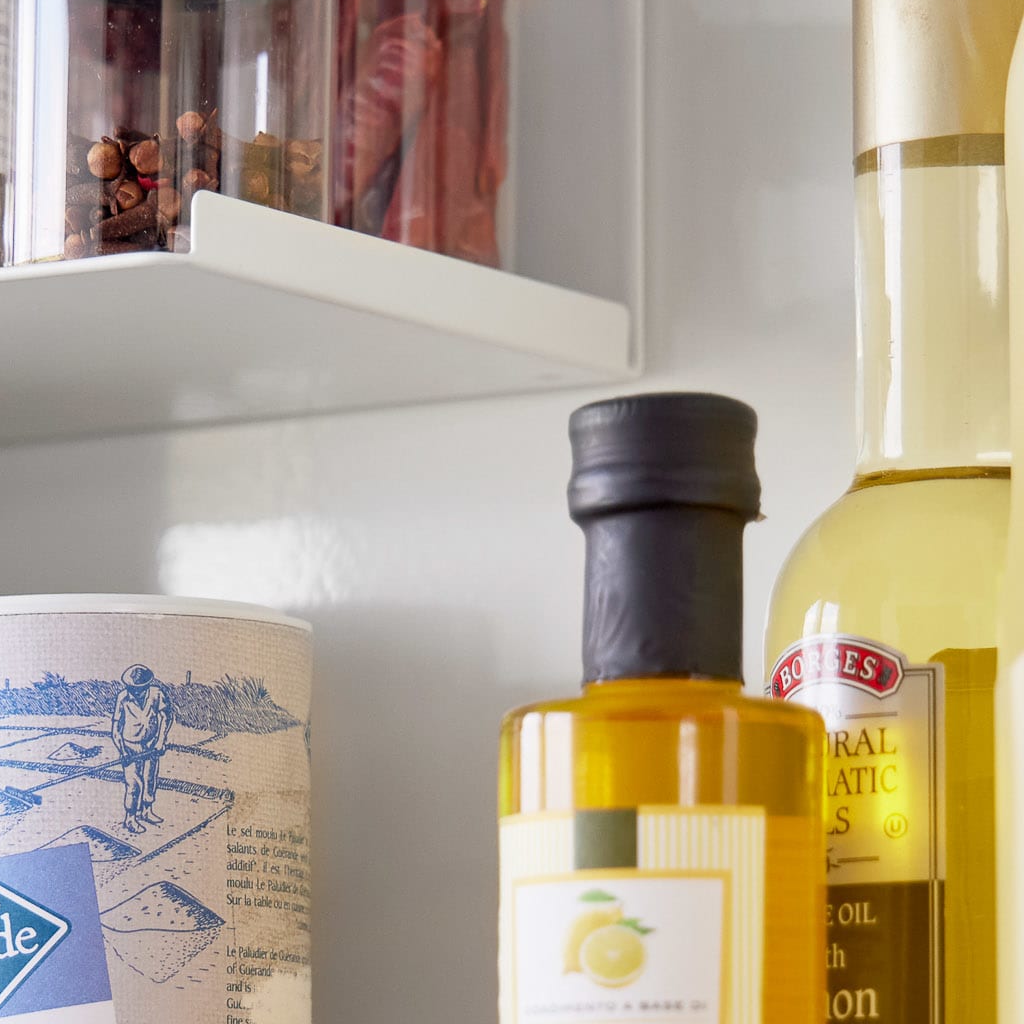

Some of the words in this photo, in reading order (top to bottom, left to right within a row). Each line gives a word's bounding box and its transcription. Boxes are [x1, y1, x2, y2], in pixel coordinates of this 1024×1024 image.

[780, 646, 877, 691] BORGES
[827, 727, 897, 758] RAL
[827, 765, 897, 797] ATIC
[226, 824, 237, 837] Le
[240, 825, 252, 838] sel
[226, 842, 257, 856] salants
[261, 845, 270, 857] de
[226, 877, 254, 890] moulu
[257, 878, 266, 890] Le
[226, 894, 242, 907] Sur
[244, 895, 252, 907] la
[254, 896, 273, 909] table
[838, 902, 877, 925] OIL
[226, 945, 236, 958] Le
[238, 946, 268, 960] Paludier
[270, 949, 278, 961] de
[226, 962, 237, 975] of
[226, 981, 243, 993] and
[245, 982, 252, 993] is
